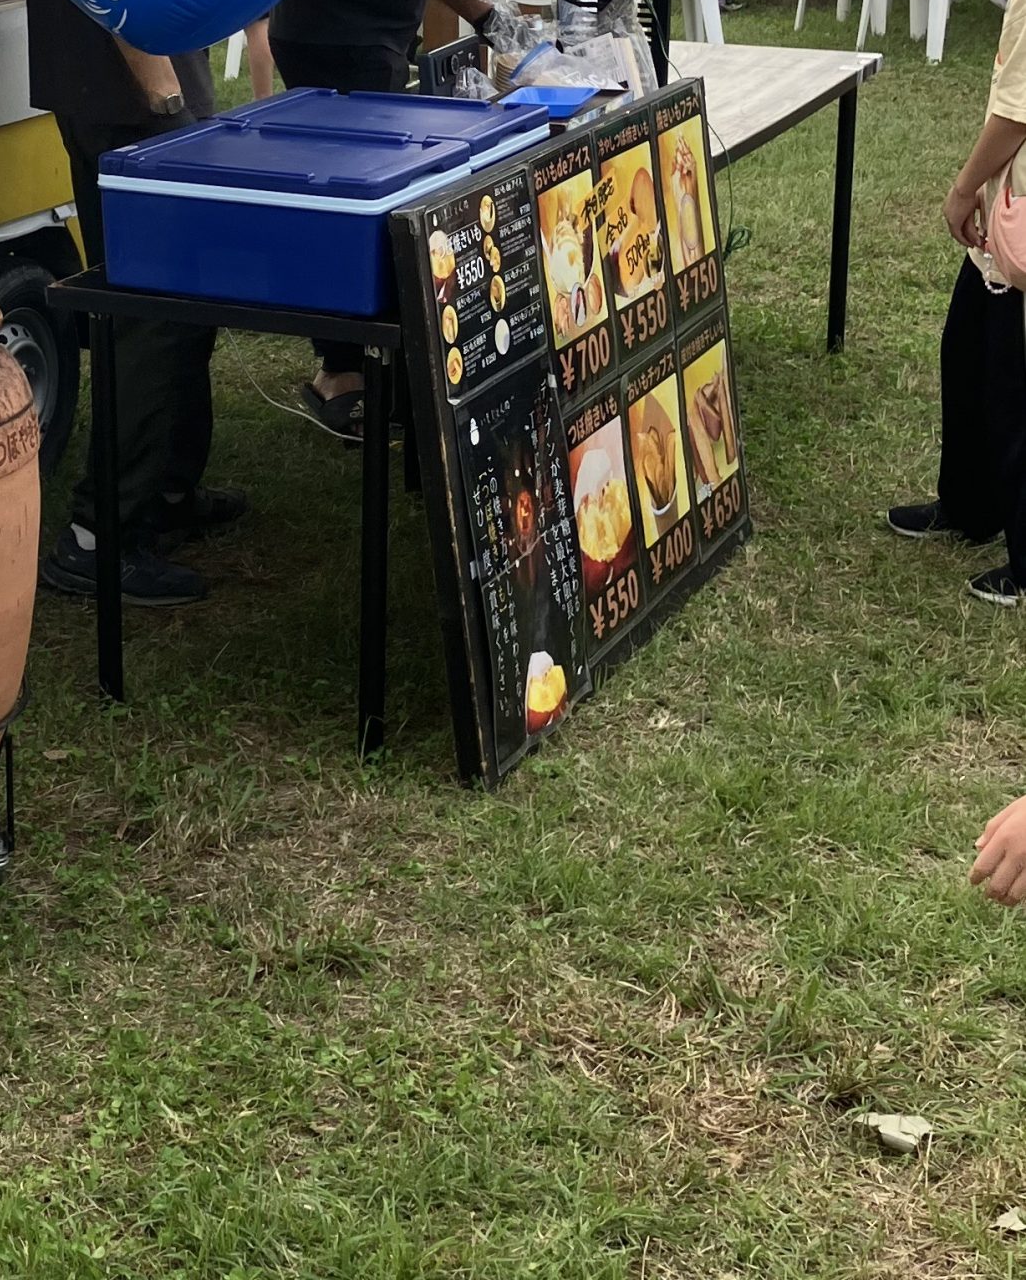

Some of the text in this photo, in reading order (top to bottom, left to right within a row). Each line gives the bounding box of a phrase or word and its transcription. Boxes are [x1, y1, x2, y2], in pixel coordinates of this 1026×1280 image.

[533, 145, 591, 191] おいもdeアイス
[456, 256, 485, 290] ¥550
[677, 256, 718, 313] ¥750
[620, 290, 667, 349] ¥550
[559, 326, 610, 391] ¥700
[568, 394, 617, 444] つぼ焼きいも
[700, 477, 741, 539] ¥650
[650, 518, 692, 585] ¥400
[589, 569, 639, 639] ¥550
